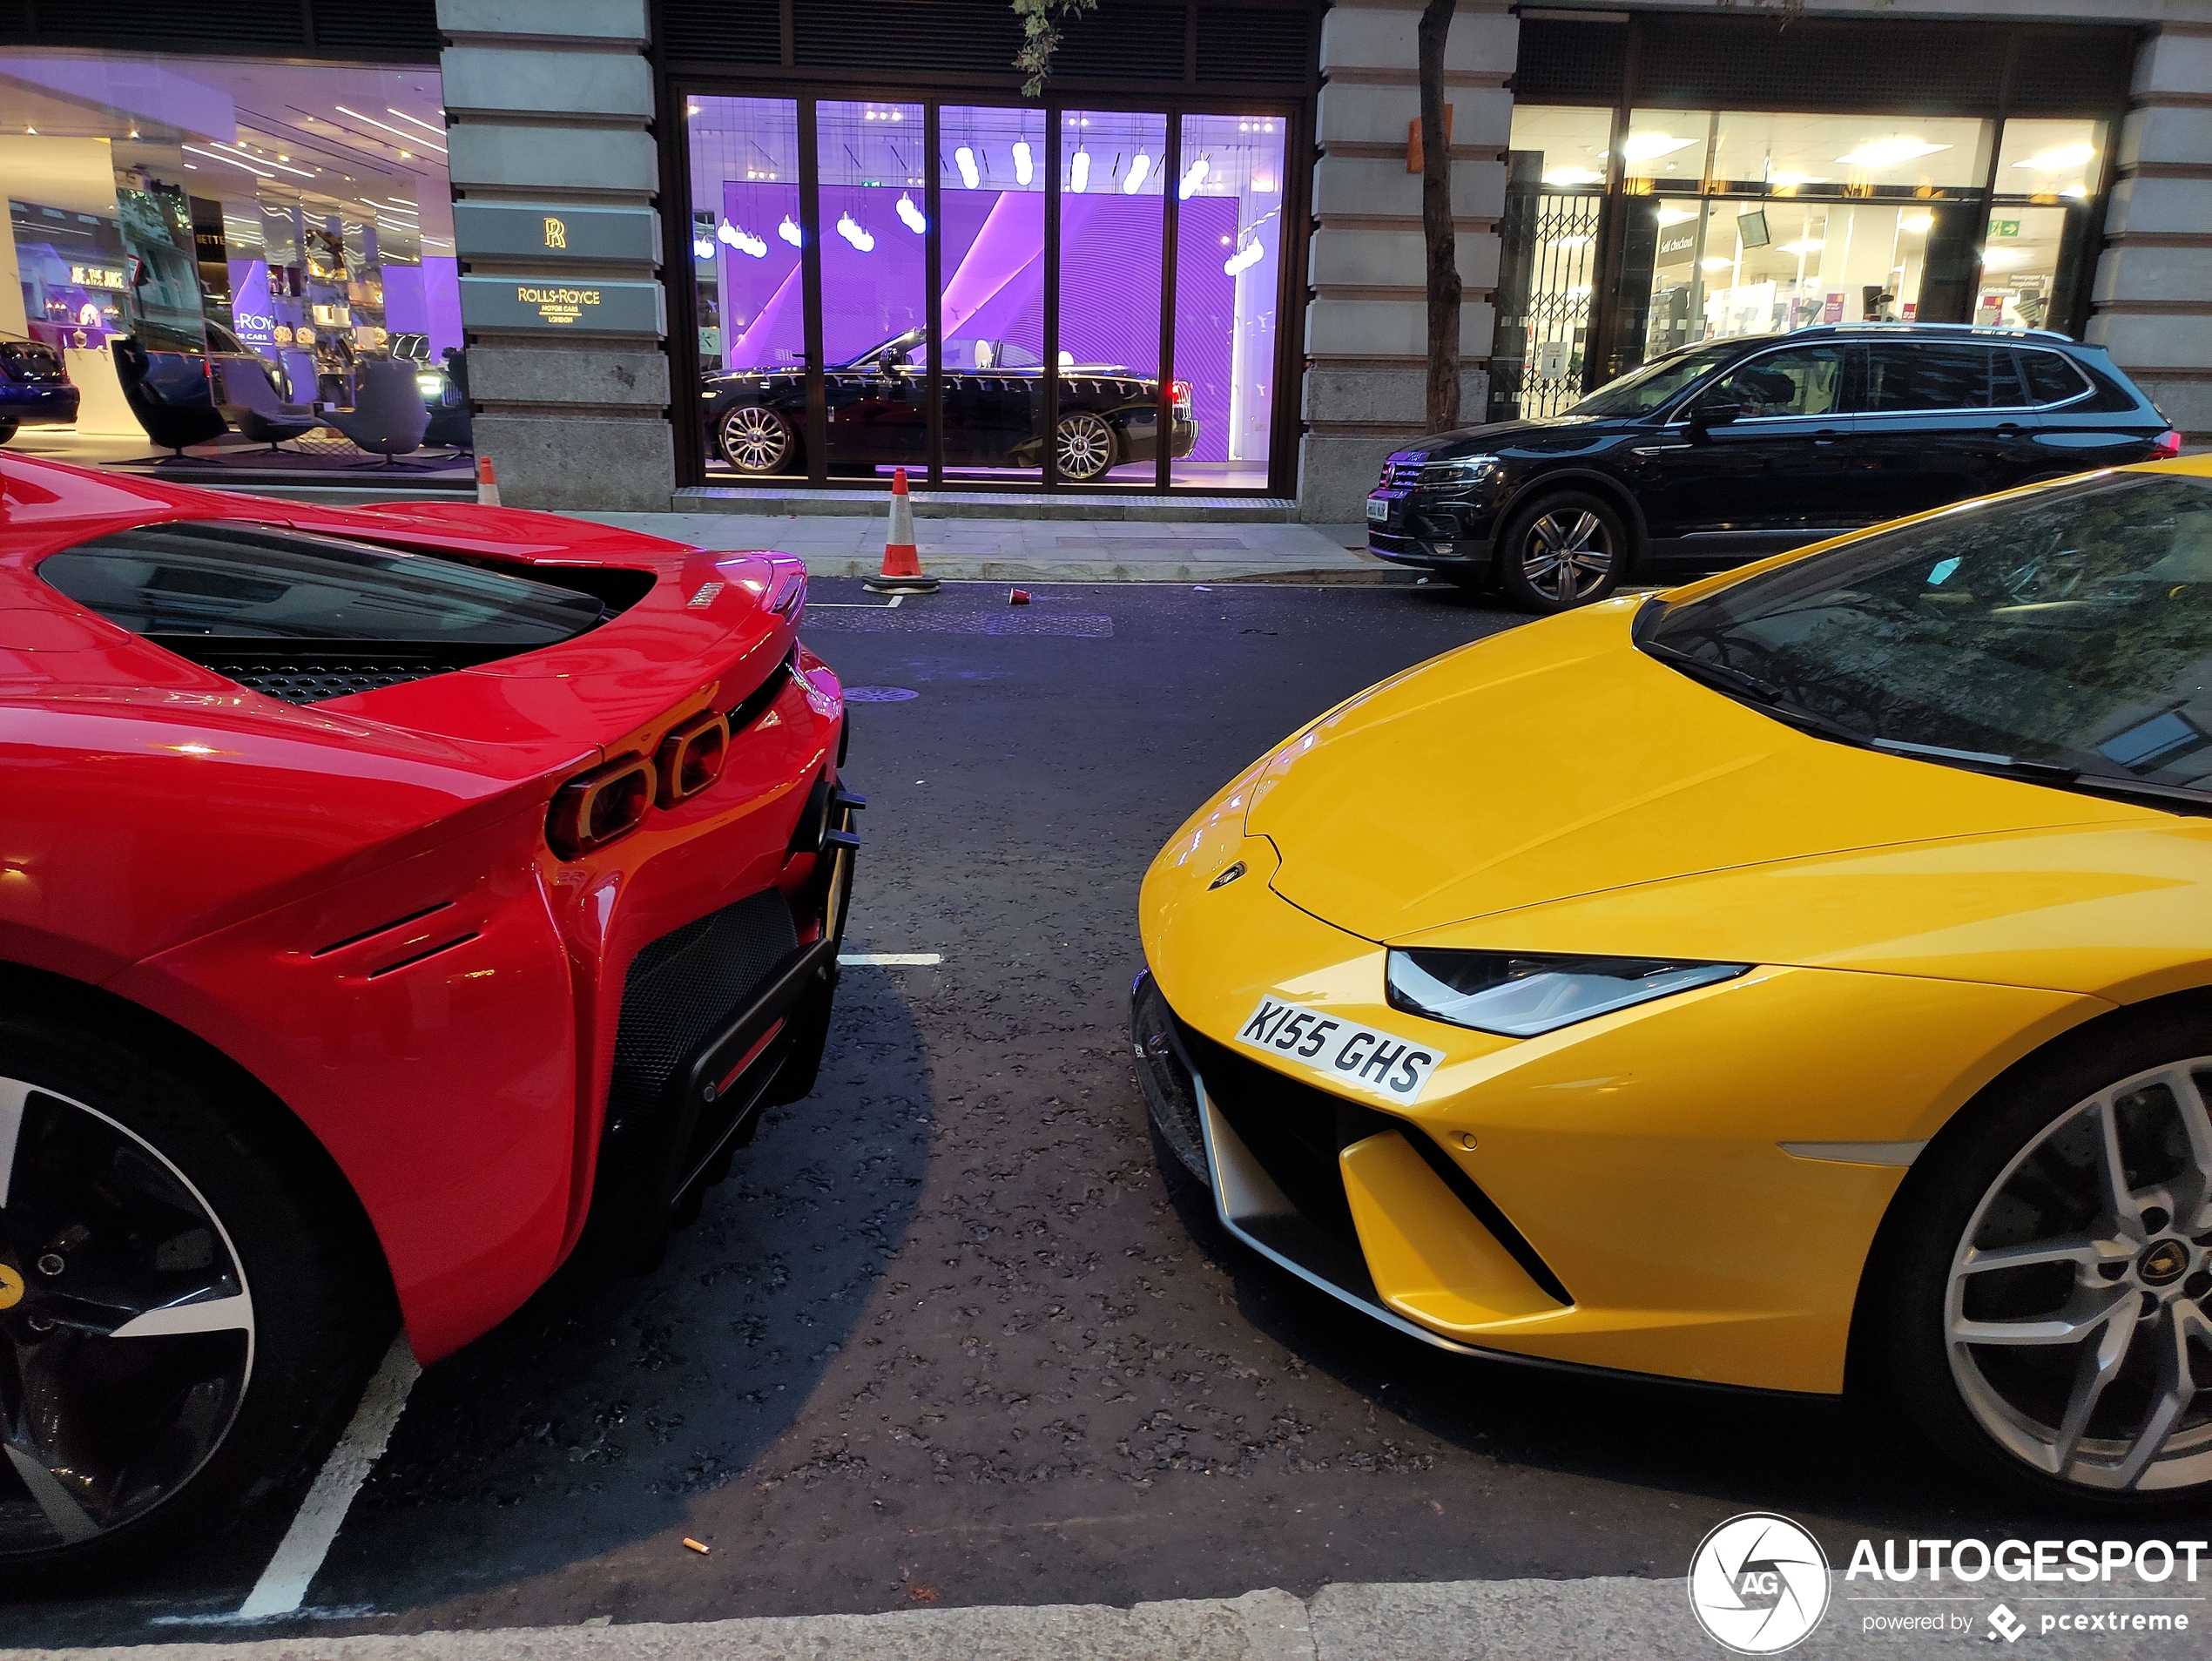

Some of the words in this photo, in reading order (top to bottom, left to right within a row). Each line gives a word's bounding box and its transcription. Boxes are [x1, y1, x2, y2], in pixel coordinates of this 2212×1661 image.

[1661, 240, 1672, 253] Self
[1671, 235, 1693, 251] checkout
[517, 287, 601, 305] ROLLS-ROYCE
[548, 315, 574, 324] LONDON
[246, 333, 267, 341] CARS
[1334, 1032, 1433, 1094] GHS
